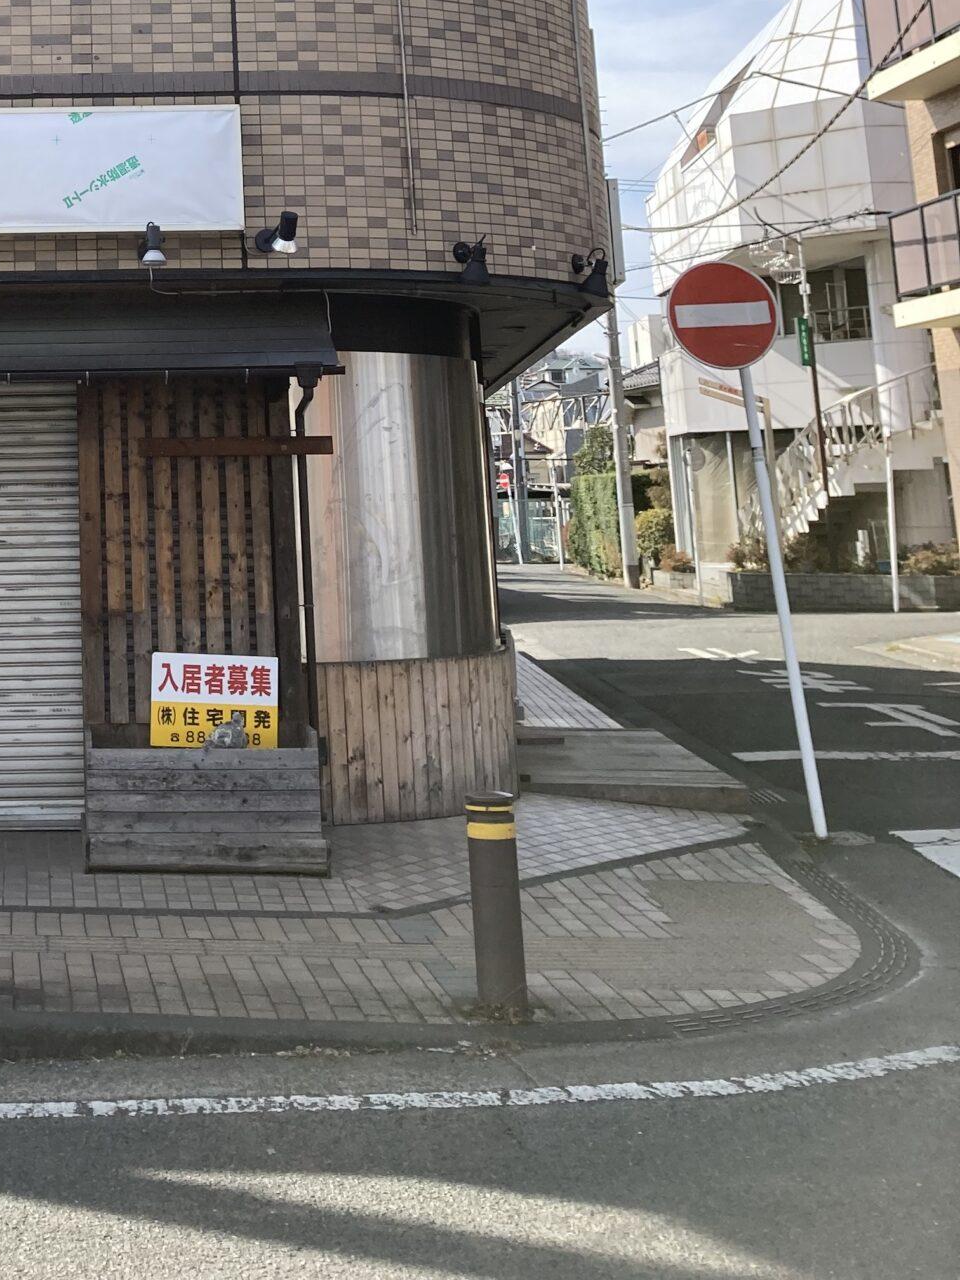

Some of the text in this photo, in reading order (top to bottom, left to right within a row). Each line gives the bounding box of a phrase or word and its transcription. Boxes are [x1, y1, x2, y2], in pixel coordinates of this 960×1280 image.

[158, 662, 271, 697] 入居者募集
